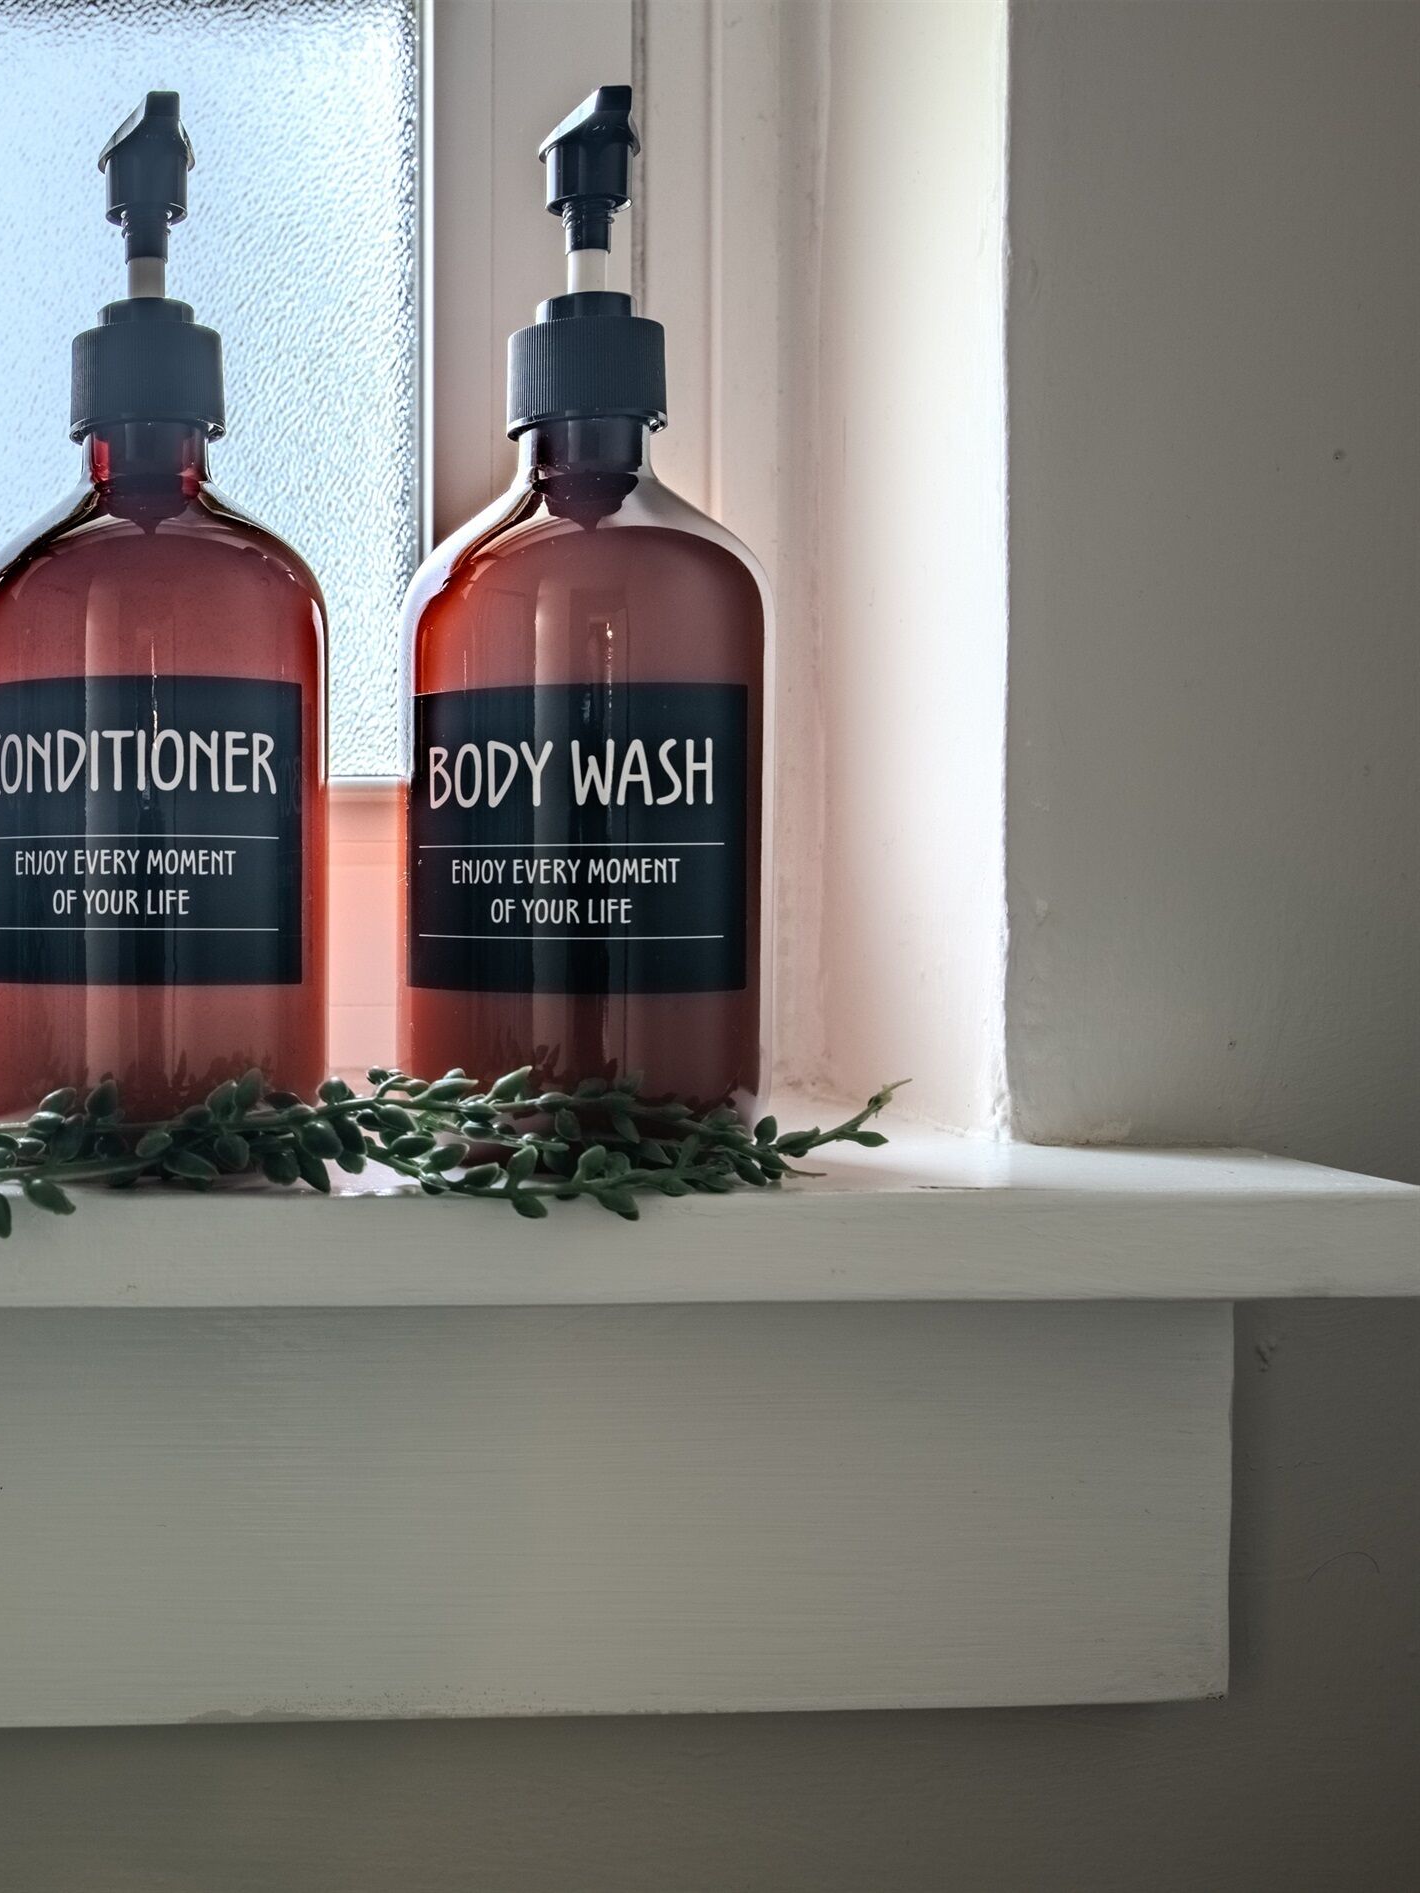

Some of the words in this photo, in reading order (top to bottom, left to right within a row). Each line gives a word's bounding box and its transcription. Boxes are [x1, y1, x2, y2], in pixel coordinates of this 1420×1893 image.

[429, 739, 554, 810] BODY
[570, 736, 714, 807] WASH
[15, 849, 68, 876] ENJOY
[74, 848, 141, 876] EVERY
[146, 848, 237, 876] MOMENT
[451, 858, 507, 885] ENJOY
[512, 858, 581, 885] EVERY
[587, 857, 681, 884] MOMENT
[52, 888, 78, 915] OF
[82, 888, 140, 916] YOUR
[146, 889, 191, 916] LIFE
[490, 898, 517, 924] OF
[521, 898, 581, 925] YOUR
[587, 898, 634, 925] LIFE
